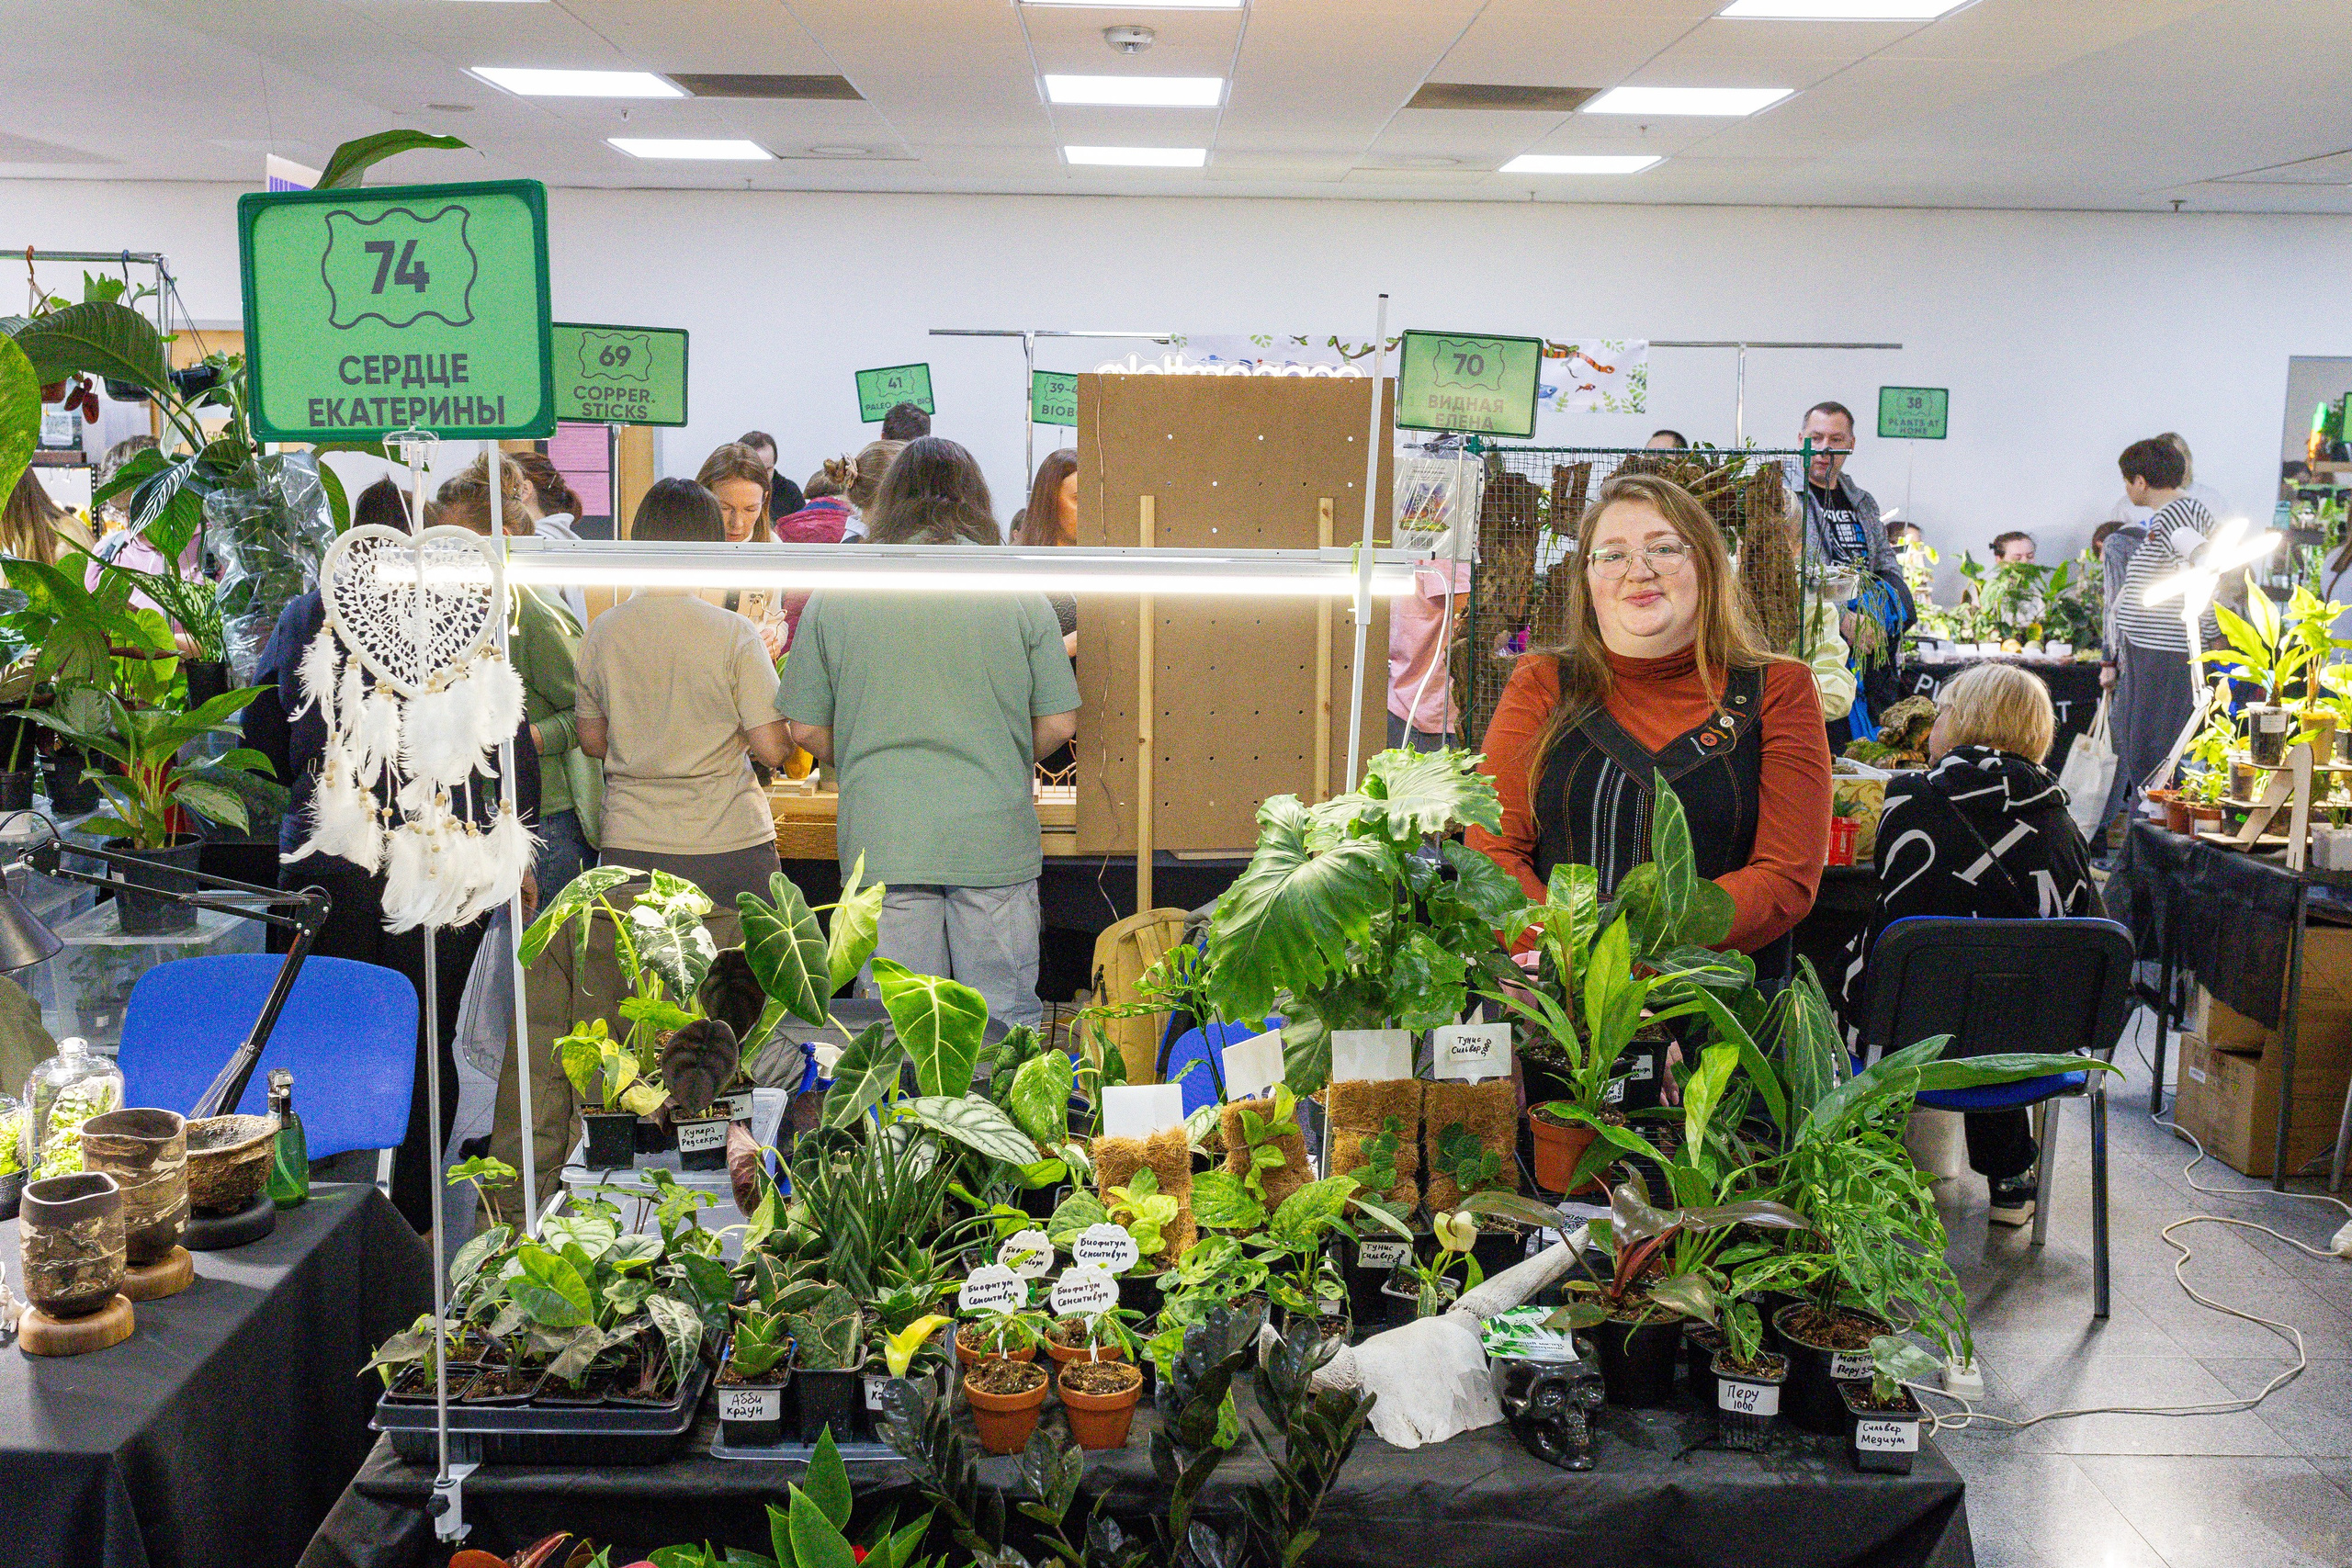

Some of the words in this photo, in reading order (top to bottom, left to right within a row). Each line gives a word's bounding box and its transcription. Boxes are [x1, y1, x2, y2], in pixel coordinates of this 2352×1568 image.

[364, 239, 430, 294] 74
[598, 344, 632, 367] 69
[338, 353, 469, 389] СЕРДЦЕ
[1453, 353, 1485, 377] 70
[888, 376, 902, 389] 41
[573, 385, 656, 404] COPPER.
[582, 401, 648, 420] STICKS
[865, 401, 892, 411] PALEO
[1041, 404, 1075, 417] BIOB
[1428, 394, 1504, 413] ВИДНАЯ
[308, 395, 505, 427] ЕКАТЕРИНЫ
[1434, 412, 1494, 431] ЕЛЕНА
[1080, 1237, 1126, 1248] Биофитум
[1079, 1249, 1128, 1261] Сенситивум
[967, 1280, 1013, 1292] Биофитум
[1057, 1282, 1101, 1295] Биофитум
[1057, 1292, 1109, 1307] Сенситивум
[731, 1392, 763, 1405] Абби
[1727, 1384, 1759, 1403] Перу
[1733, 1400, 1754, 1412] 1000
[1862, 1422, 1902, 1436] Сильвер
[1860, 1434, 1905, 1447] Медиум
